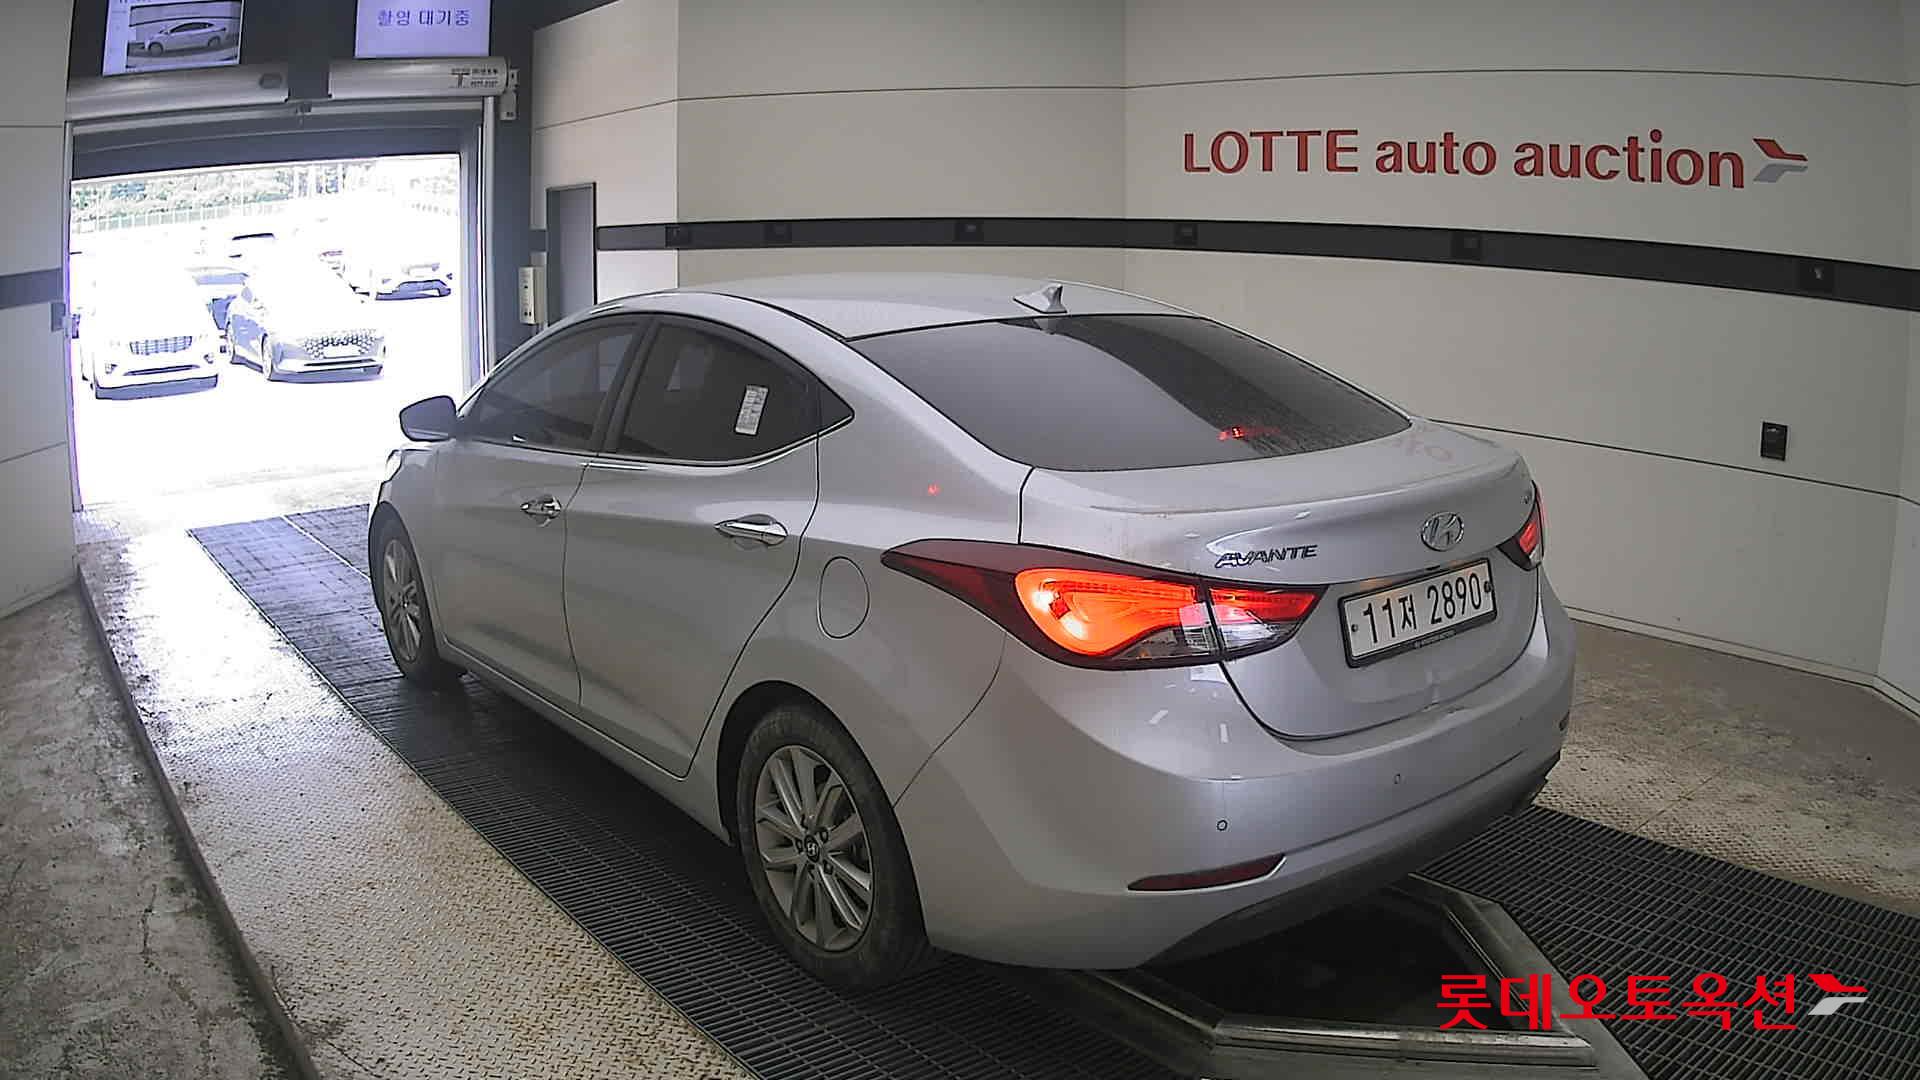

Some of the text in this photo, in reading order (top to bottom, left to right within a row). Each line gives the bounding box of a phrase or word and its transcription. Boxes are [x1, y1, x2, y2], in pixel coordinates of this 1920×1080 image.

[419, 9, 469, 26] 대기중
[1184, 129, 1745, 189] LOTTE auto auction
[1214, 544, 1318, 569] AVANTE
[1362, 594, 1417, 644] 11저
[1427, 572, 1483, 625] 2890
